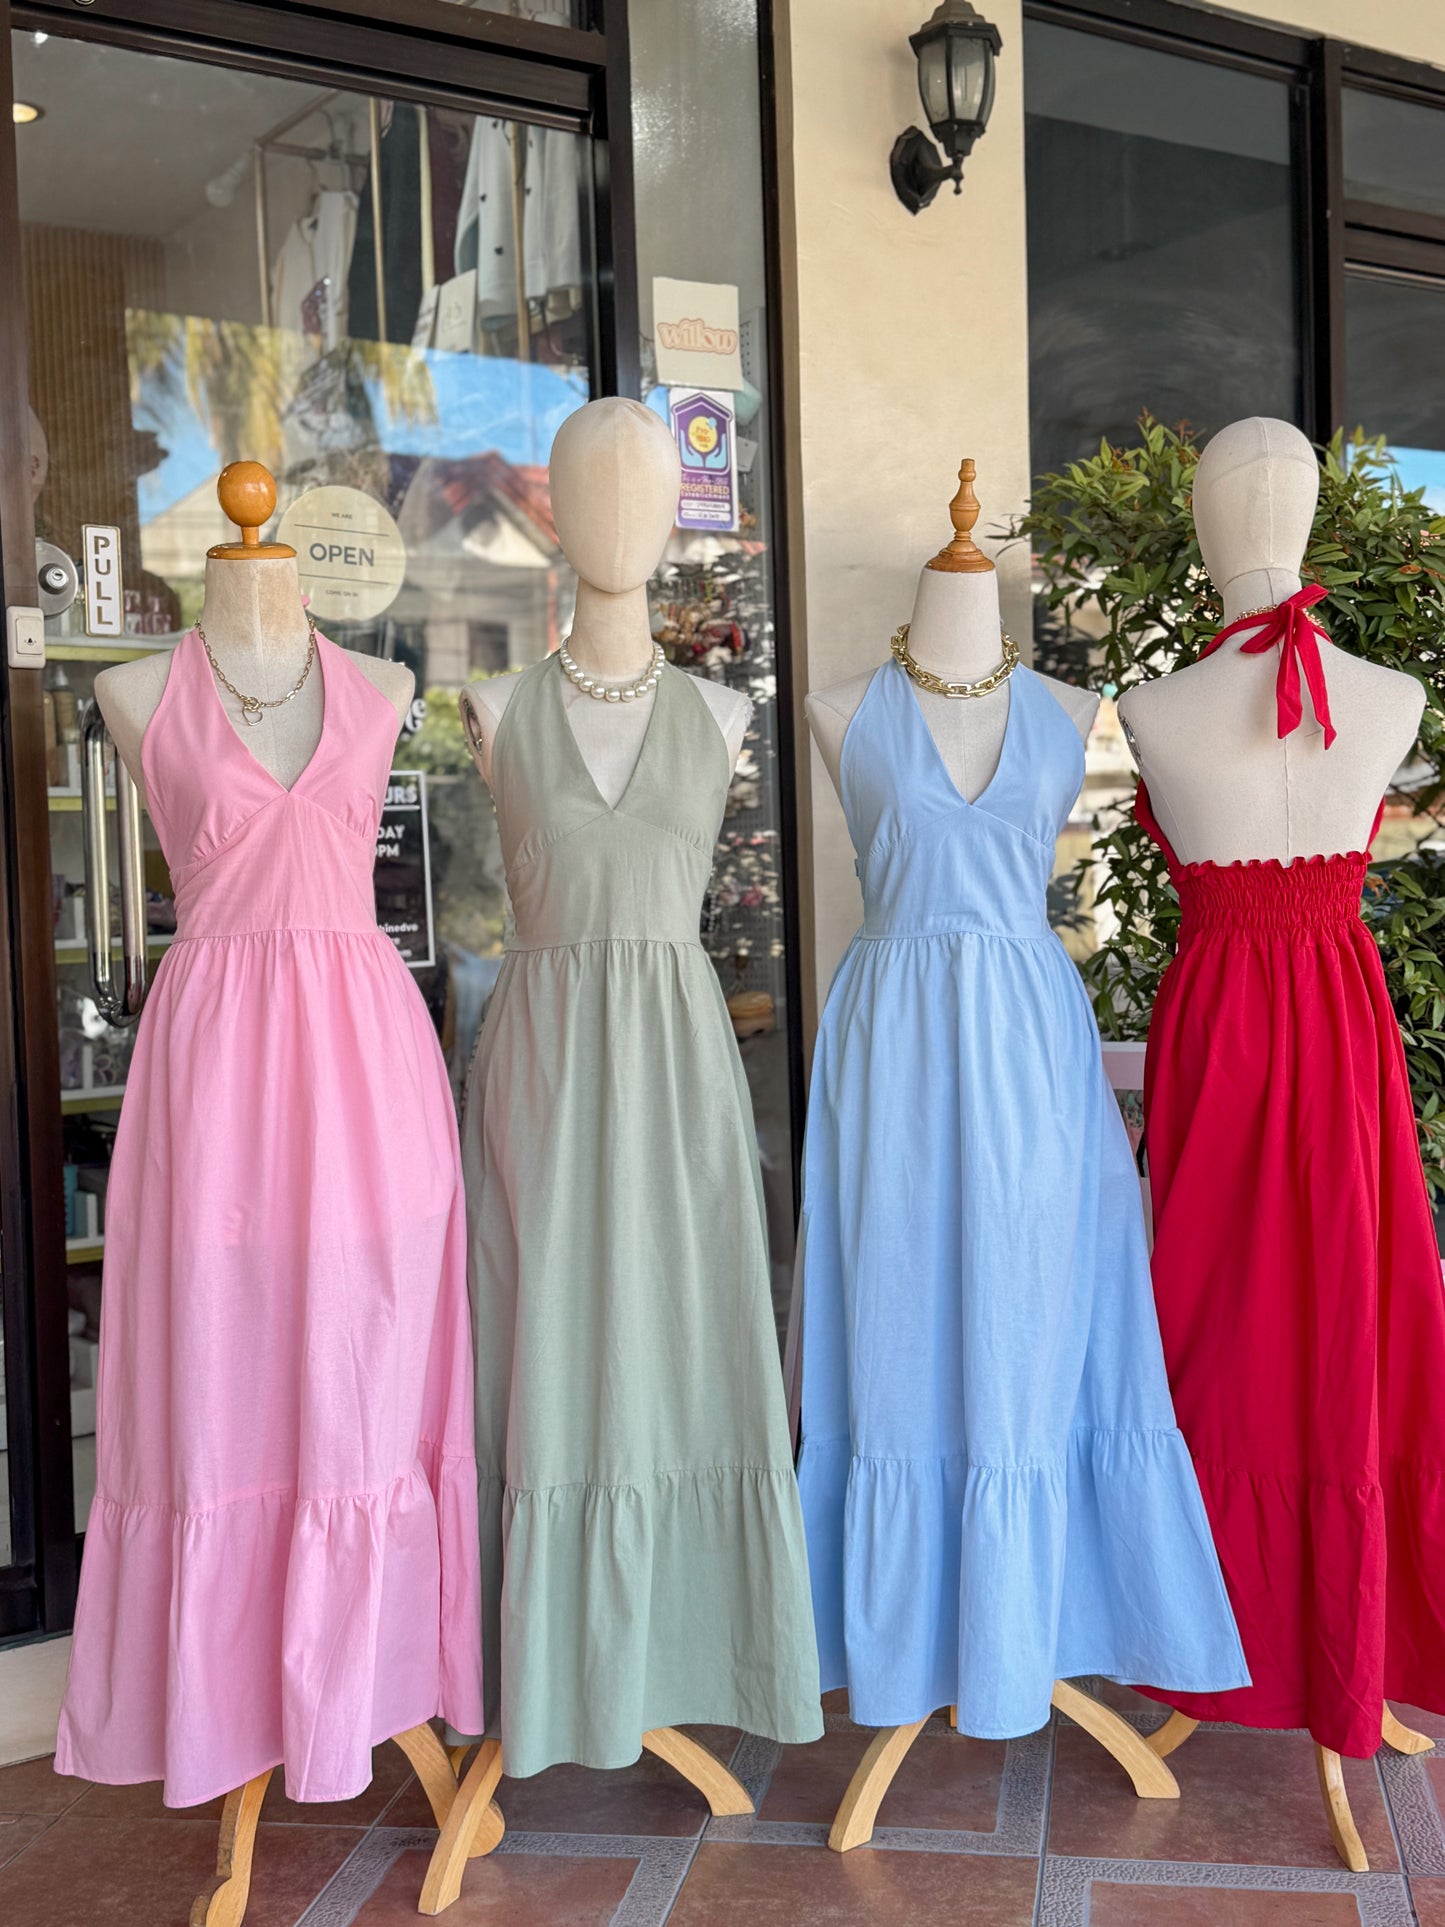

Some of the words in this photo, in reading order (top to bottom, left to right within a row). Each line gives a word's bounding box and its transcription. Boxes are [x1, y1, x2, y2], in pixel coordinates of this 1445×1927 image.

[657, 318, 738, 355] willow
[680, 482, 730, 495] REGISTERED
[309, 543, 374, 567] OPEN
[93, 535, 113, 626] PULL
